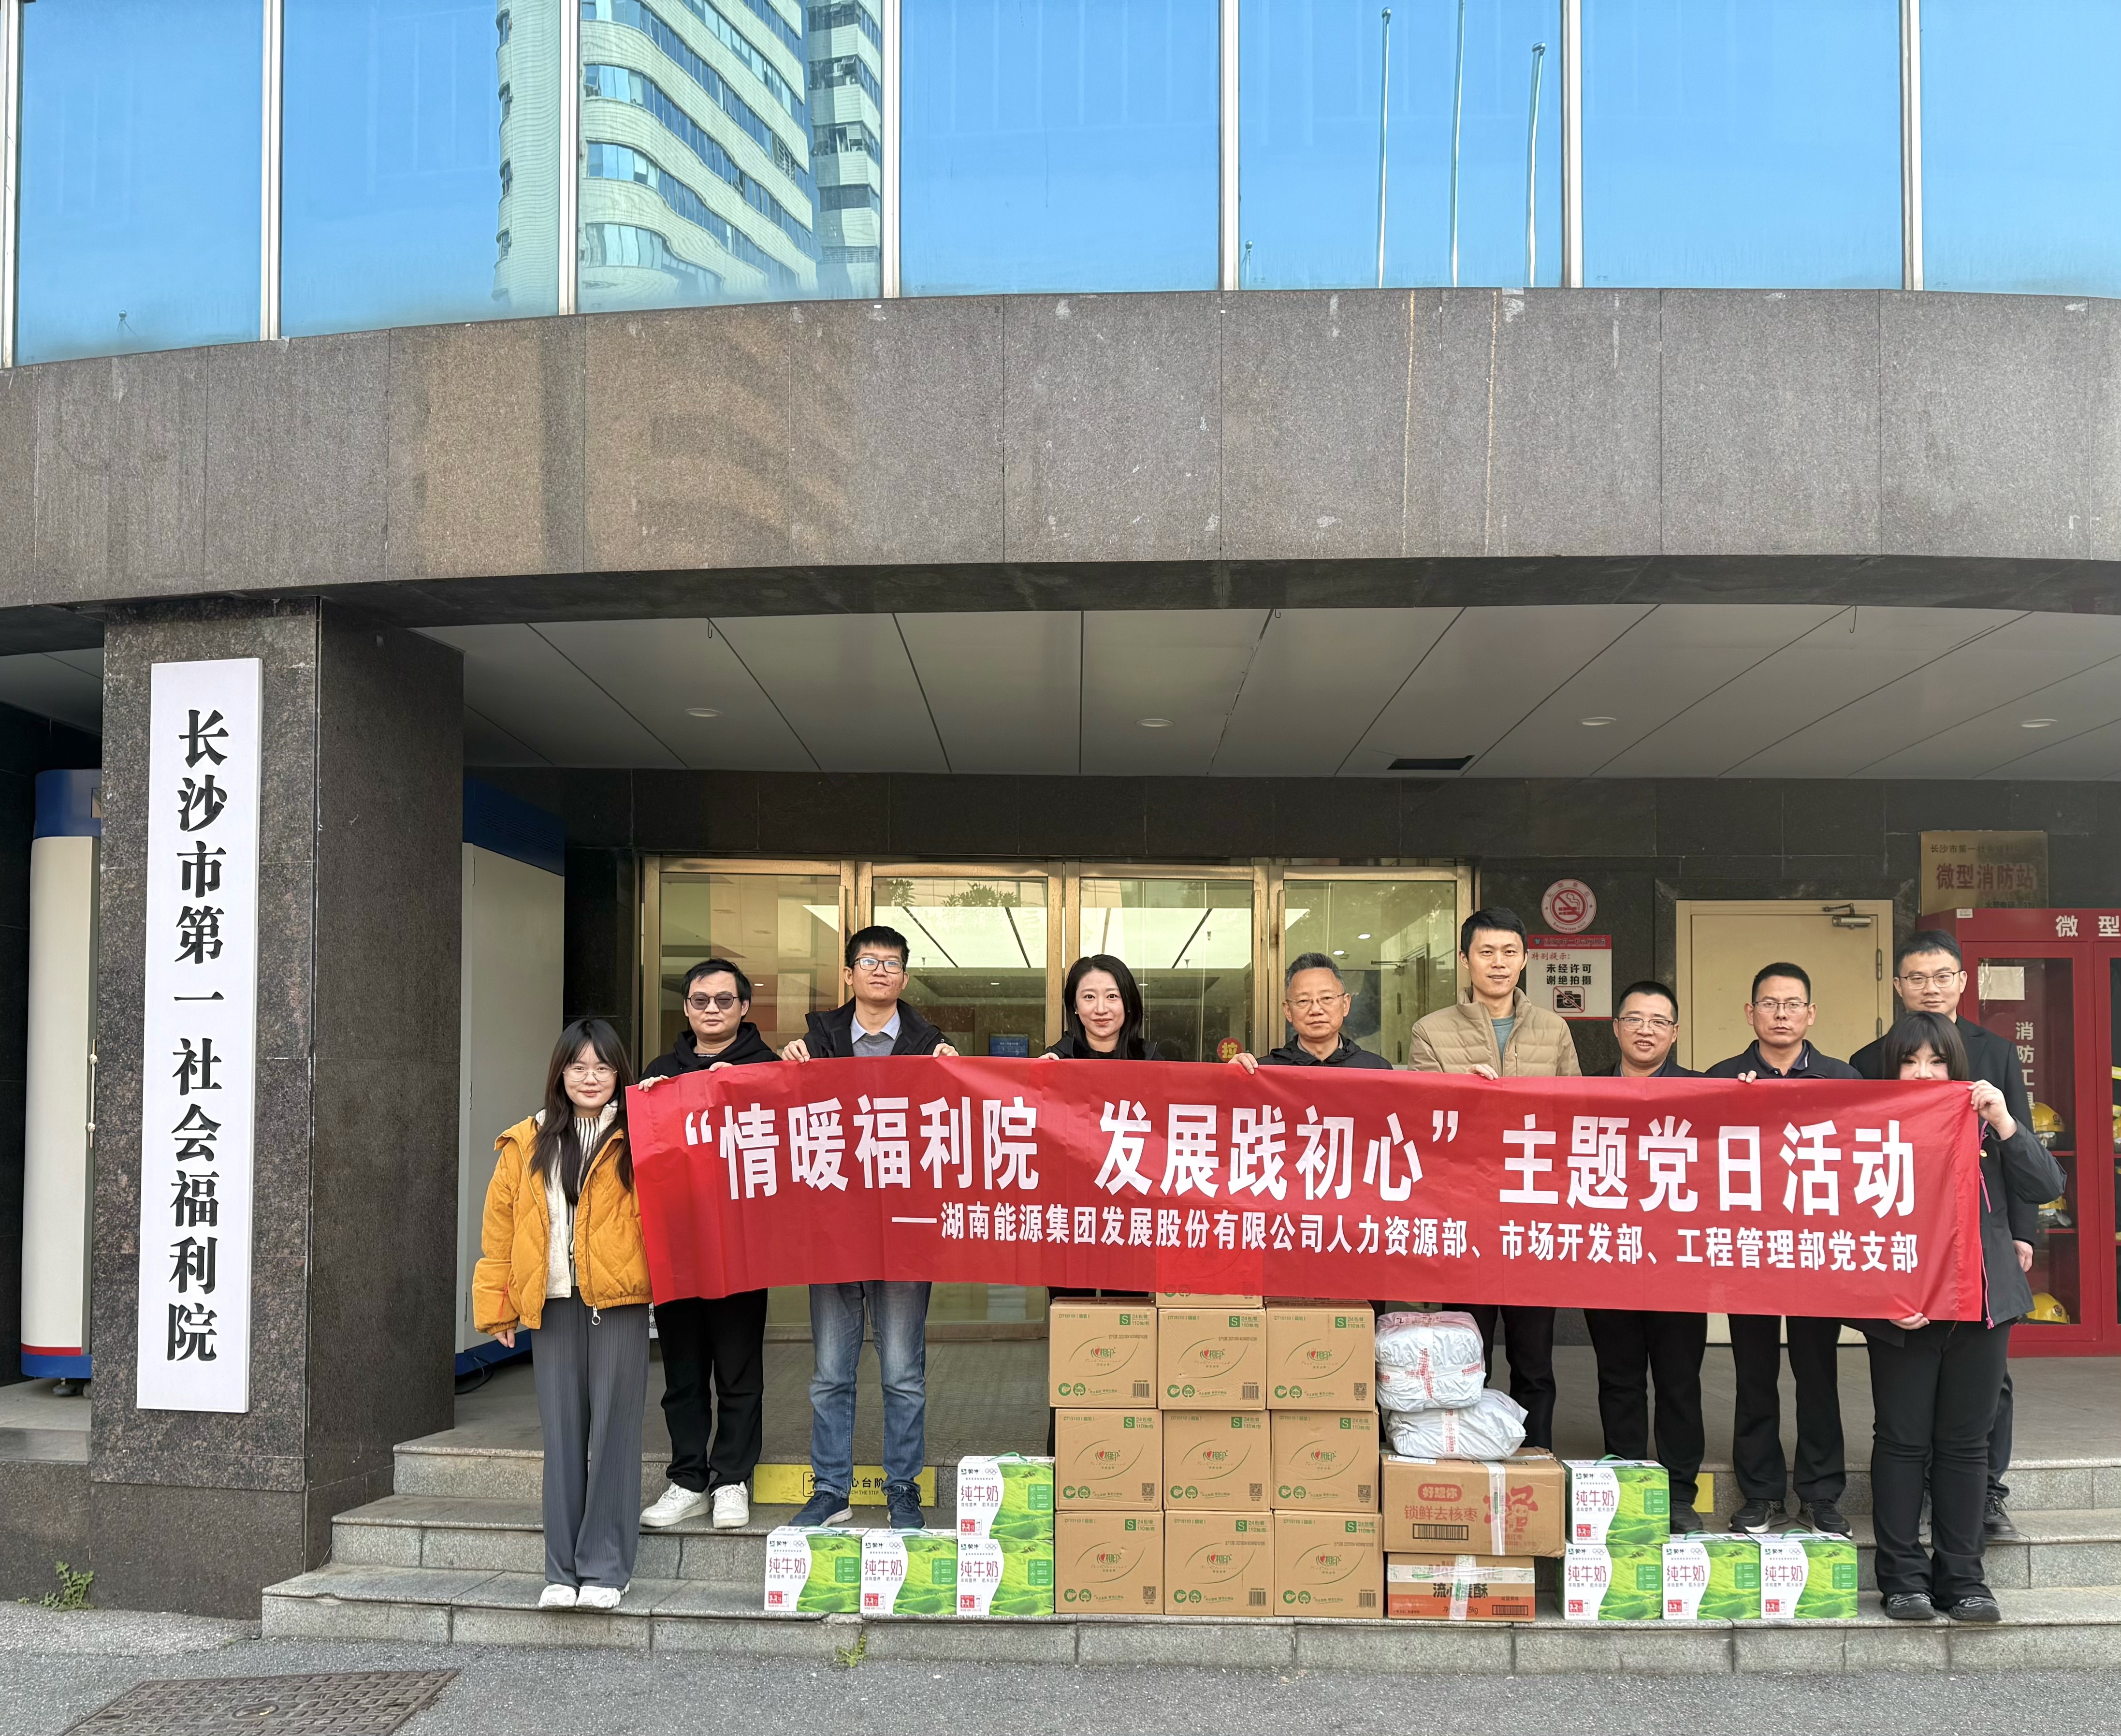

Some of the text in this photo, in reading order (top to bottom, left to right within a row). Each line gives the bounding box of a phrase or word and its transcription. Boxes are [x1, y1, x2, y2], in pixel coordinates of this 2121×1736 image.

[1936, 863, 2034, 890] 微型消防站
[1547, 964, 1592, 973] 未经许可
[1547, 976, 1592, 985] 谢绝拍摄
[167, 709, 229, 1361] 长沙市第一社会福利院
[1221, 1042, 1238, 1059] 拉
[1499, 1113, 1915, 1219] 主题党日活动
[1121, 1315, 1129, 1325] S
[1230, 1317, 1238, 1326] S
[1337, 1317, 1344, 1327] S
[1125, 1417, 1133, 1428] S
[1233, 1417, 1240, 1428] S
[1341, 1418, 1349, 1428] S
[961, 1485, 998, 1502] 纯牛奶
[1423, 1486, 1458, 1499] 好想你
[1576, 1490, 1614, 1506] 纯牛奶
[1404, 1505, 1478, 1522] 锁鲜去核枣
[1127, 1520, 1134, 1530] S
[1237, 1520, 1245, 1531] S
[1347, 1522, 1354, 1532] S
[769, 1558, 806, 1574] 纯牛奶
[865, 1559, 902, 1576] 纯牛奶
[961, 1561, 998, 1577] 纯牛奶
[1568, 1565, 1606, 1582] 纯牛奶
[1667, 1565, 1705, 1581] 纯牛奶
[1765, 1565, 1803, 1581] 纯牛奶
